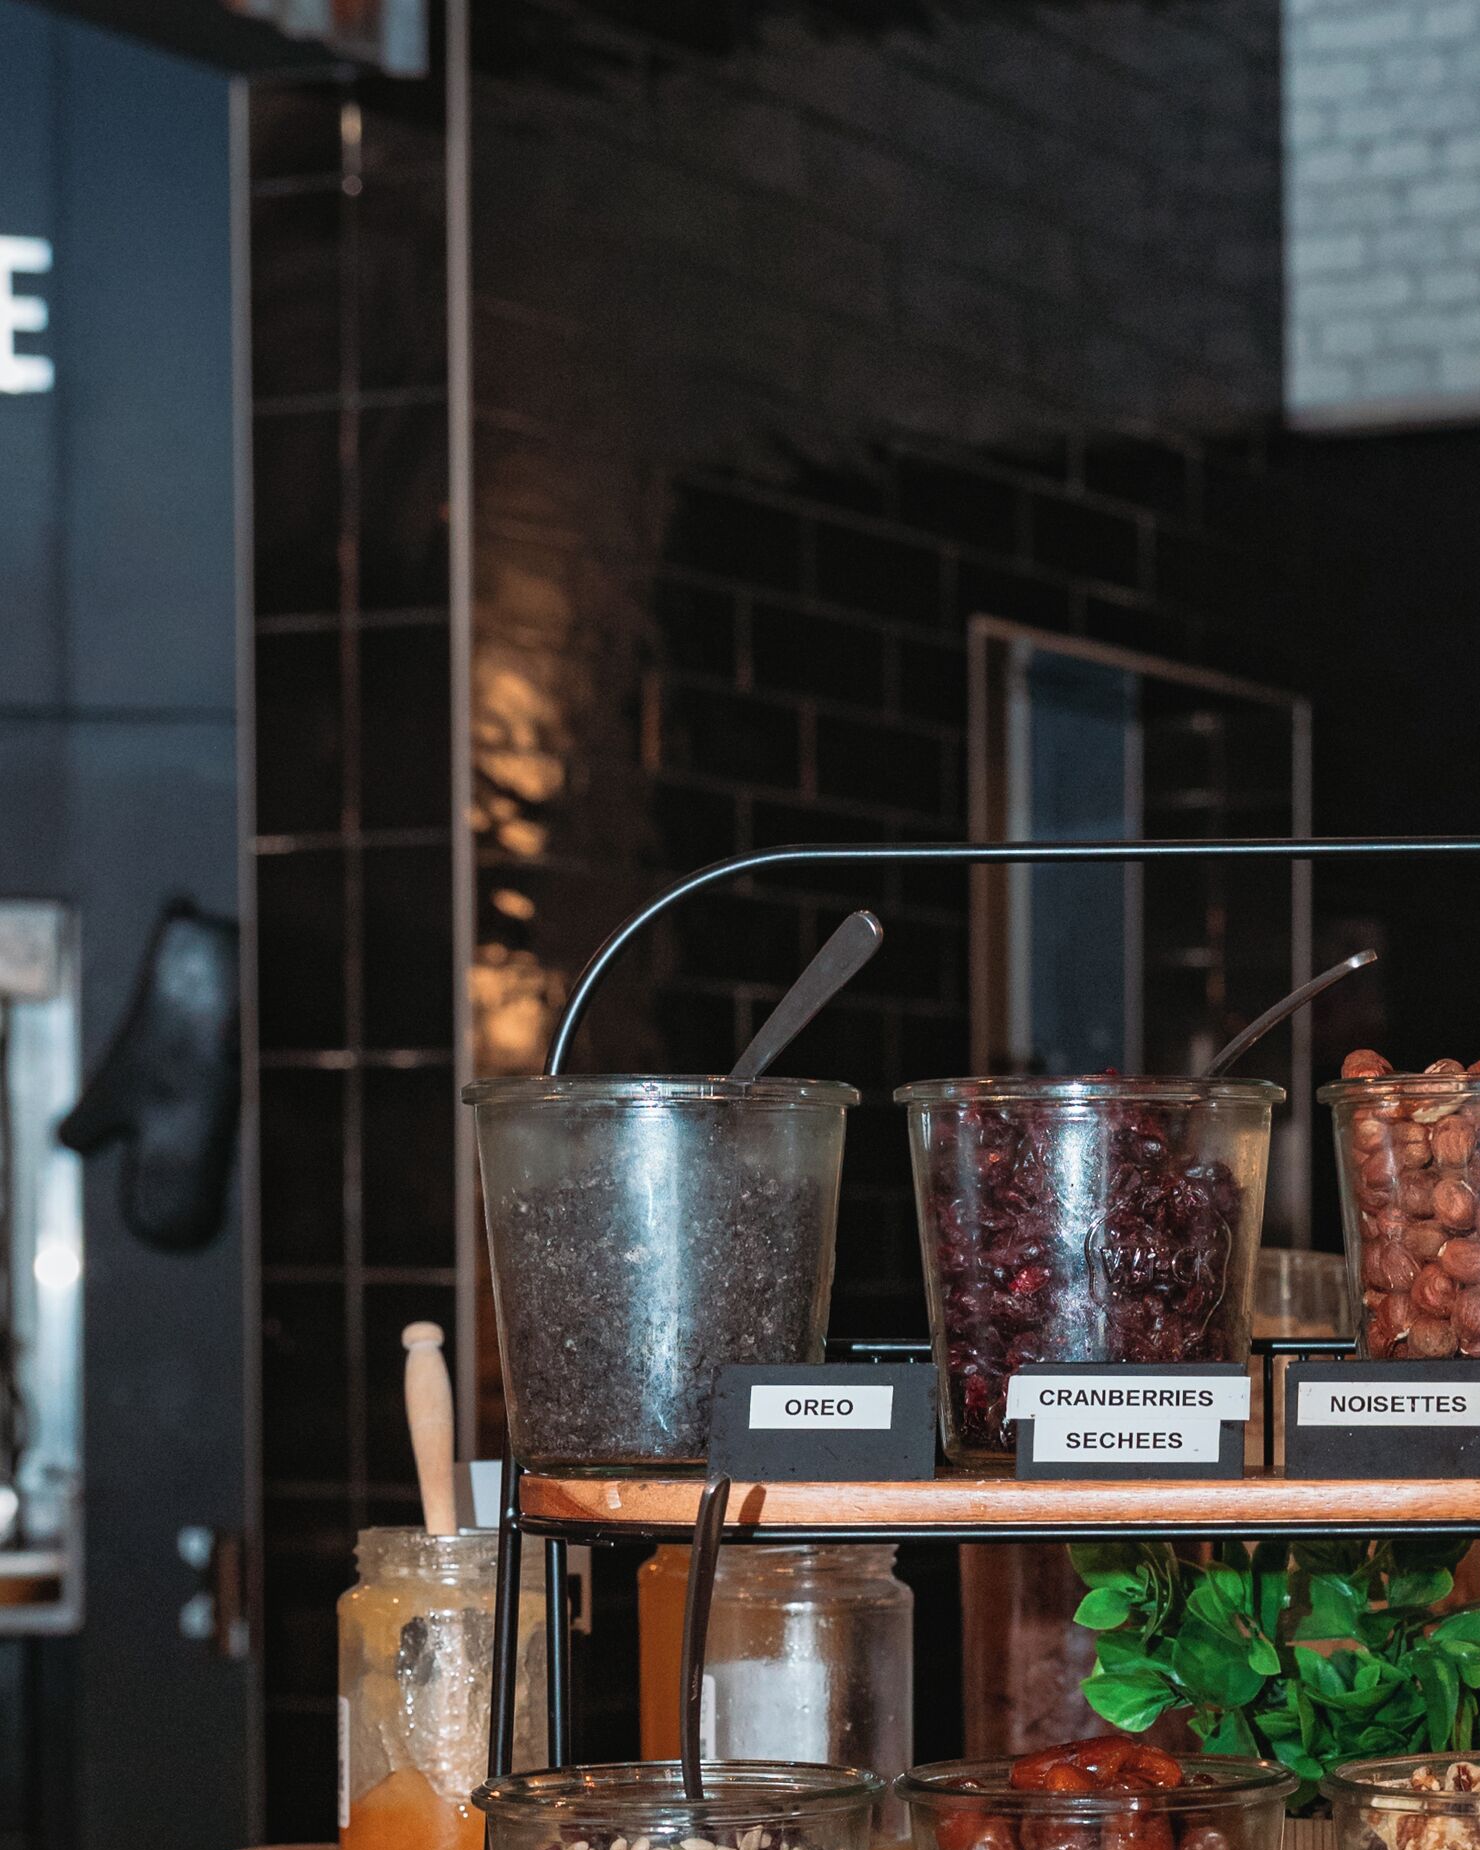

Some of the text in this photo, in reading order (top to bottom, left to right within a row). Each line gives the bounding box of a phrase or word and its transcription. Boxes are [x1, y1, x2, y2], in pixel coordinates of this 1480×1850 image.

[0, 235, 55, 393] E
[784, 1399, 854, 1416] OREO
[1039, 1388, 1214, 1408] CRANBERRIES
[1330, 1395, 1467, 1413] NOISETTES
[1065, 1431, 1183, 1450] SECHEES
